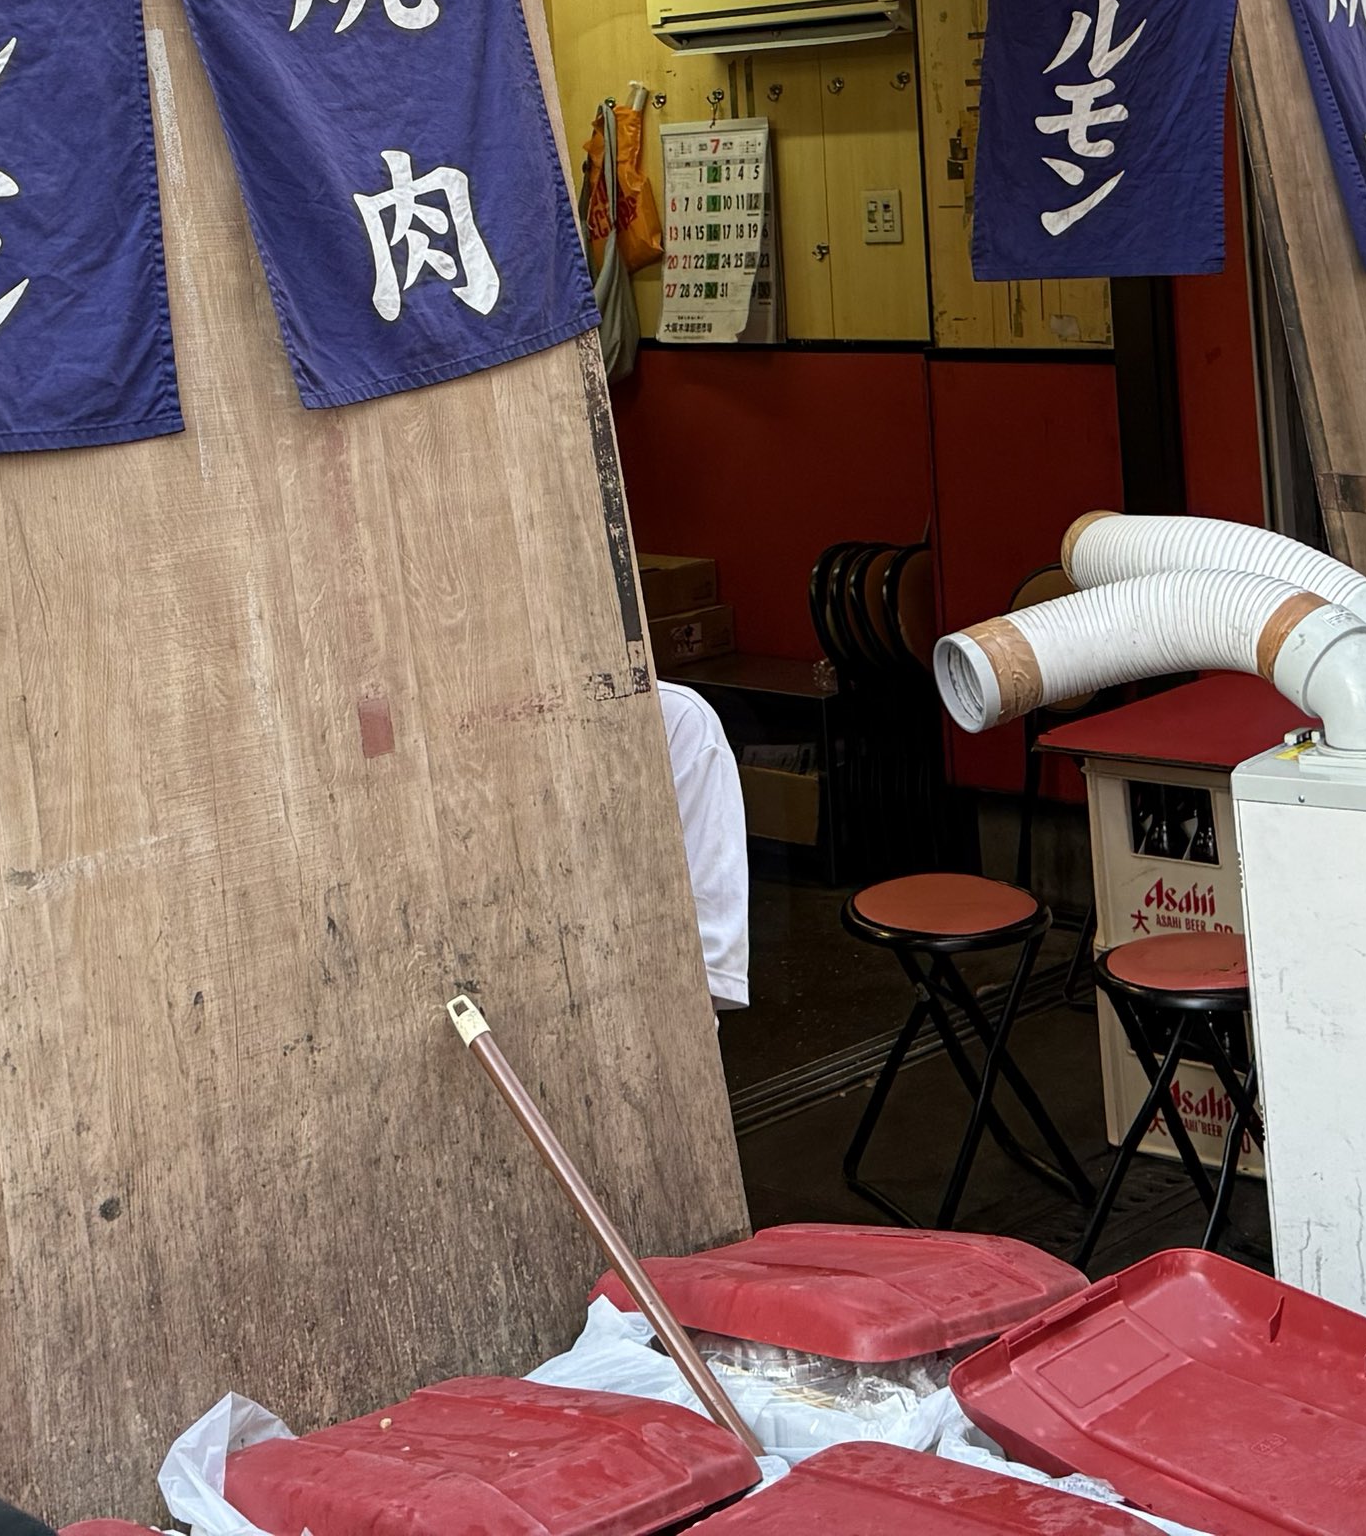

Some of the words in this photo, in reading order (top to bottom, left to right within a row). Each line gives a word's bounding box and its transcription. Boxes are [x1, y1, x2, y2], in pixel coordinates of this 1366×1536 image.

[710, 139, 720, 154] 7
[1144, 877, 1216, 917] Asahi
[1130, 909, 1150, 934] 大
[1156, 914, 1182, 929] ASAHI
[1185, 917, 1207, 932] BEER
